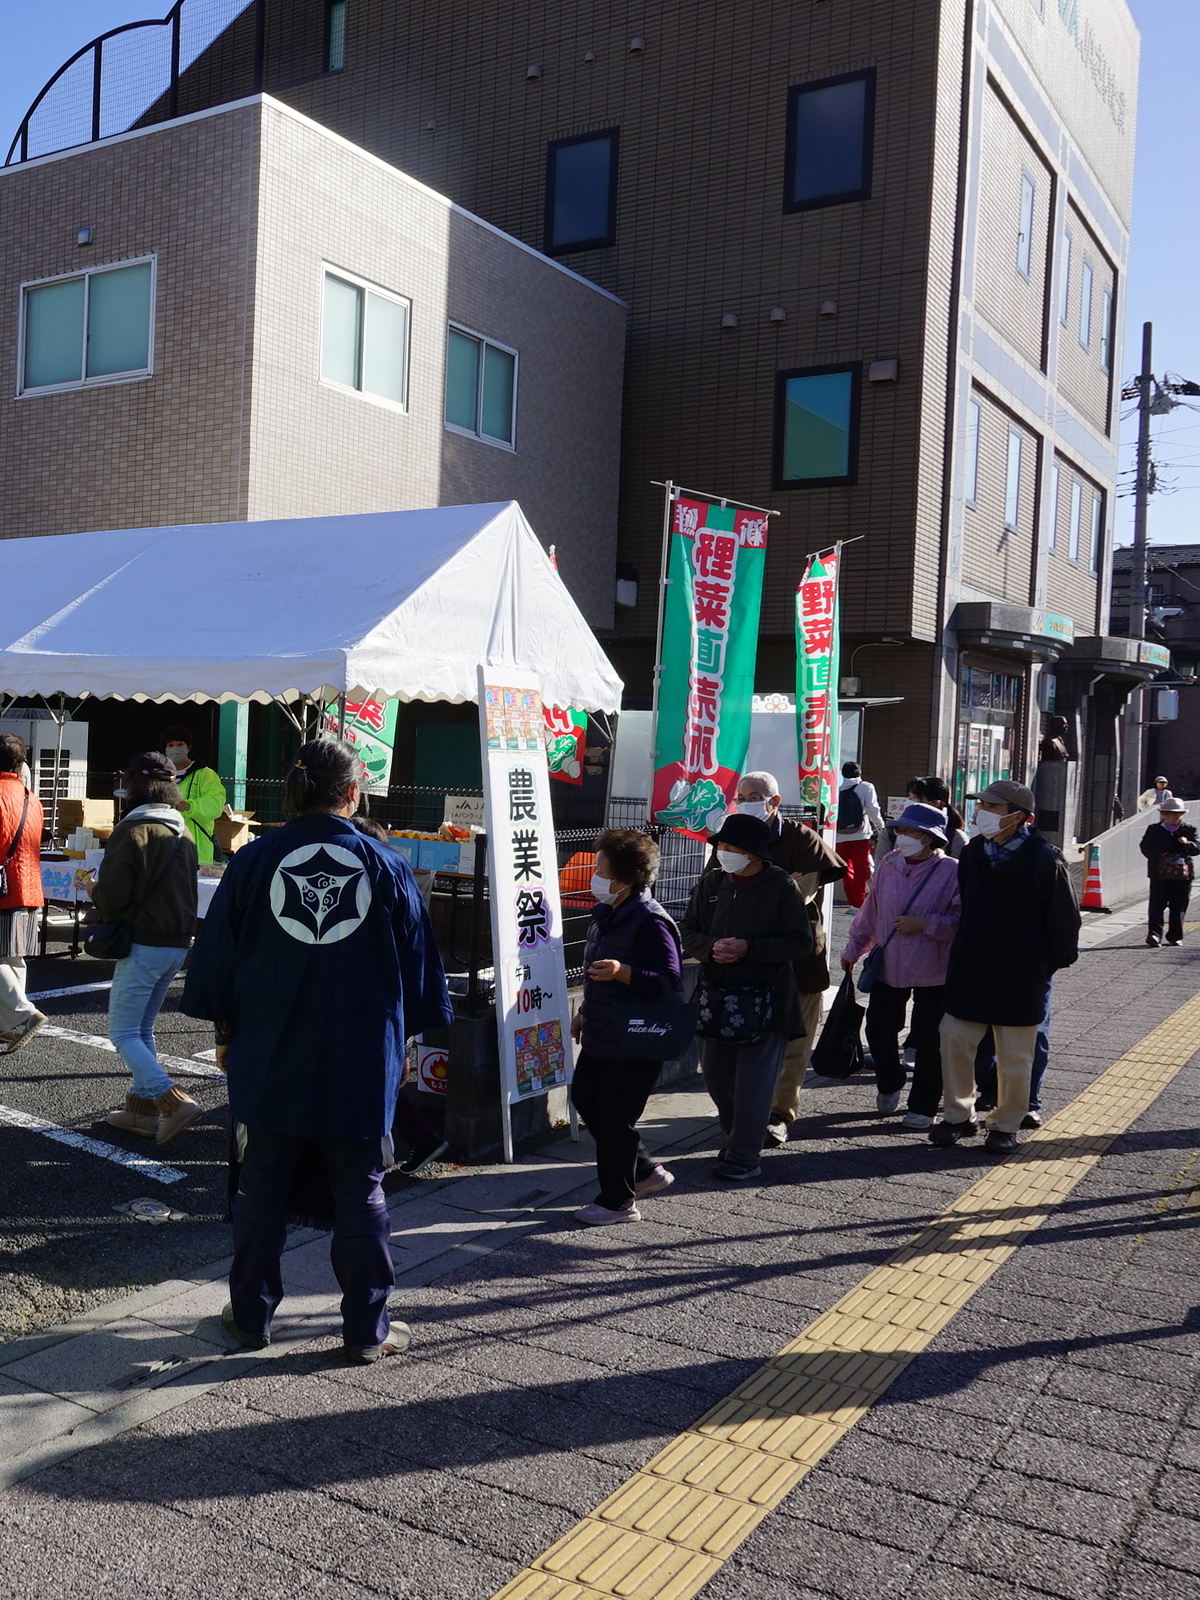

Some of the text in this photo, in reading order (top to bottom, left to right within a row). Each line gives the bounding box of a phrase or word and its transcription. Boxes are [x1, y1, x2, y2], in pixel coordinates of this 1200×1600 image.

[508, 767, 549, 944] 農業祭
[515, 964, 532, 981] 午前
